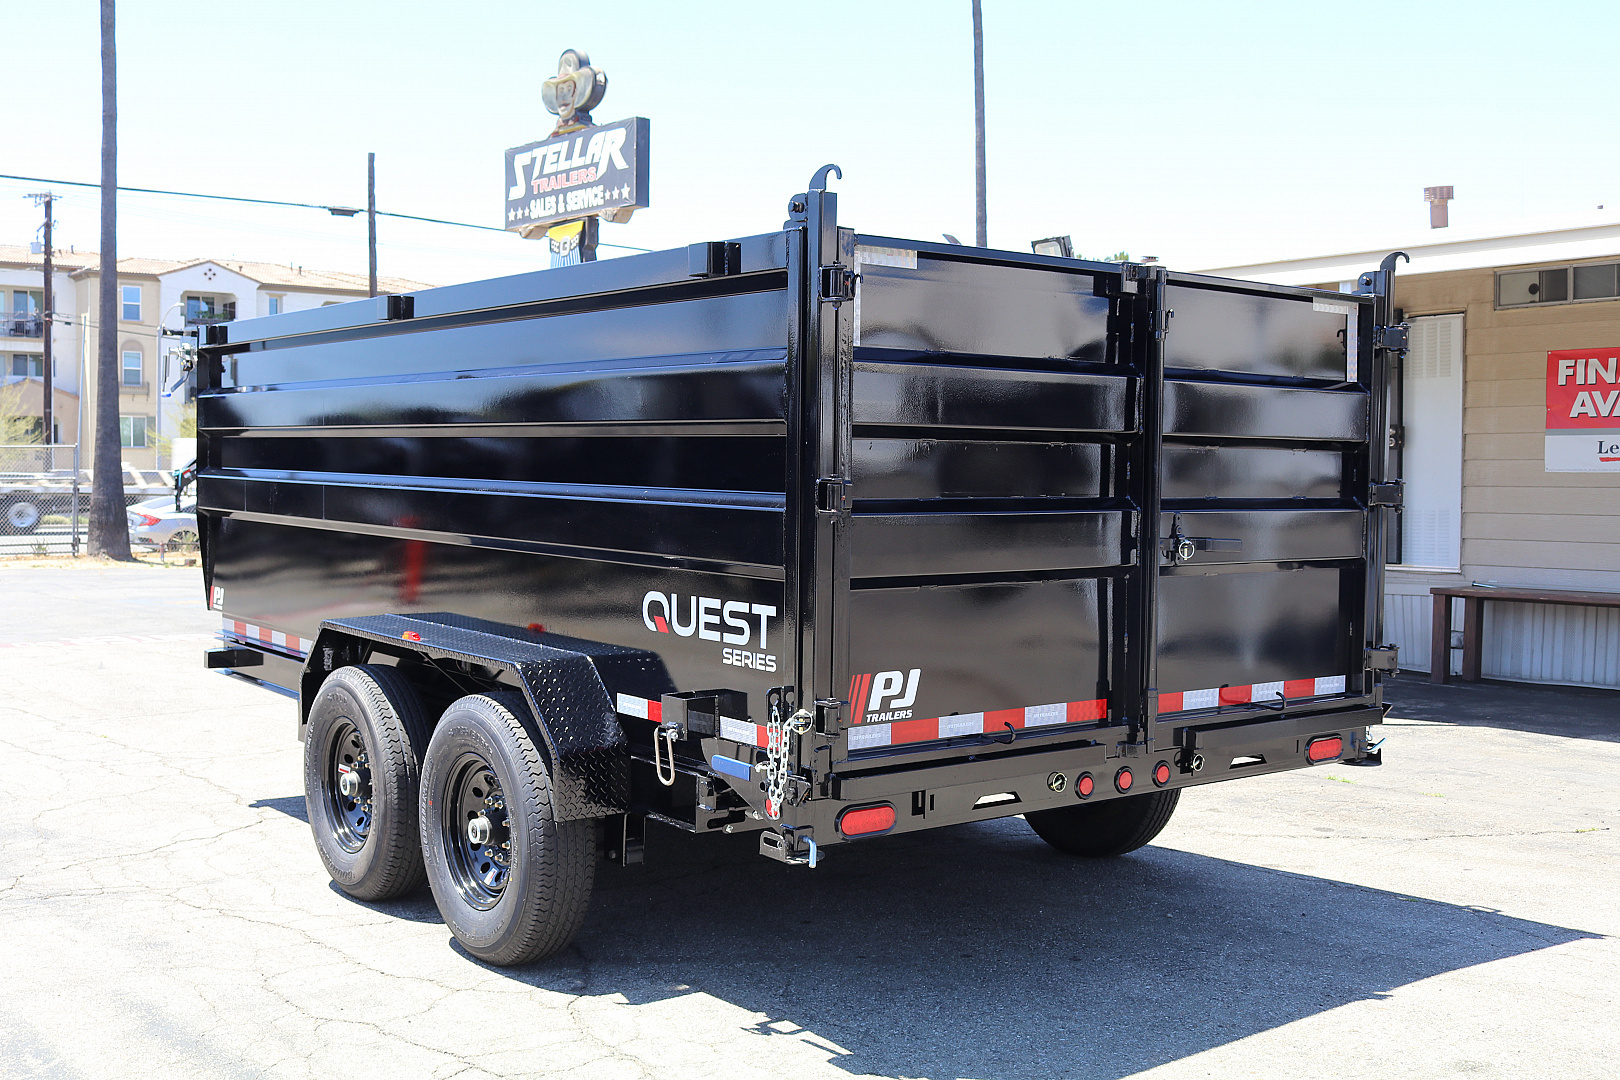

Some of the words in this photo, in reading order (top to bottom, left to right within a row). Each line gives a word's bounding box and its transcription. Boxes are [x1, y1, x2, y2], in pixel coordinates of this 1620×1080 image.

[508, 127, 630, 201] STELLAR
[531, 167, 597, 194] TRAILERS
[529, 193, 557, 219] SALES
[558, 193, 566, 213] &
[566, 185, 605, 212] SERVICE
[1557, 357, 1620, 386] FIN
[642, 590, 777, 650] QUEST
[722, 647, 777, 673] SERIES
[868, 668, 922, 712] PJ
[866, 709, 913, 723] TRAILERS
